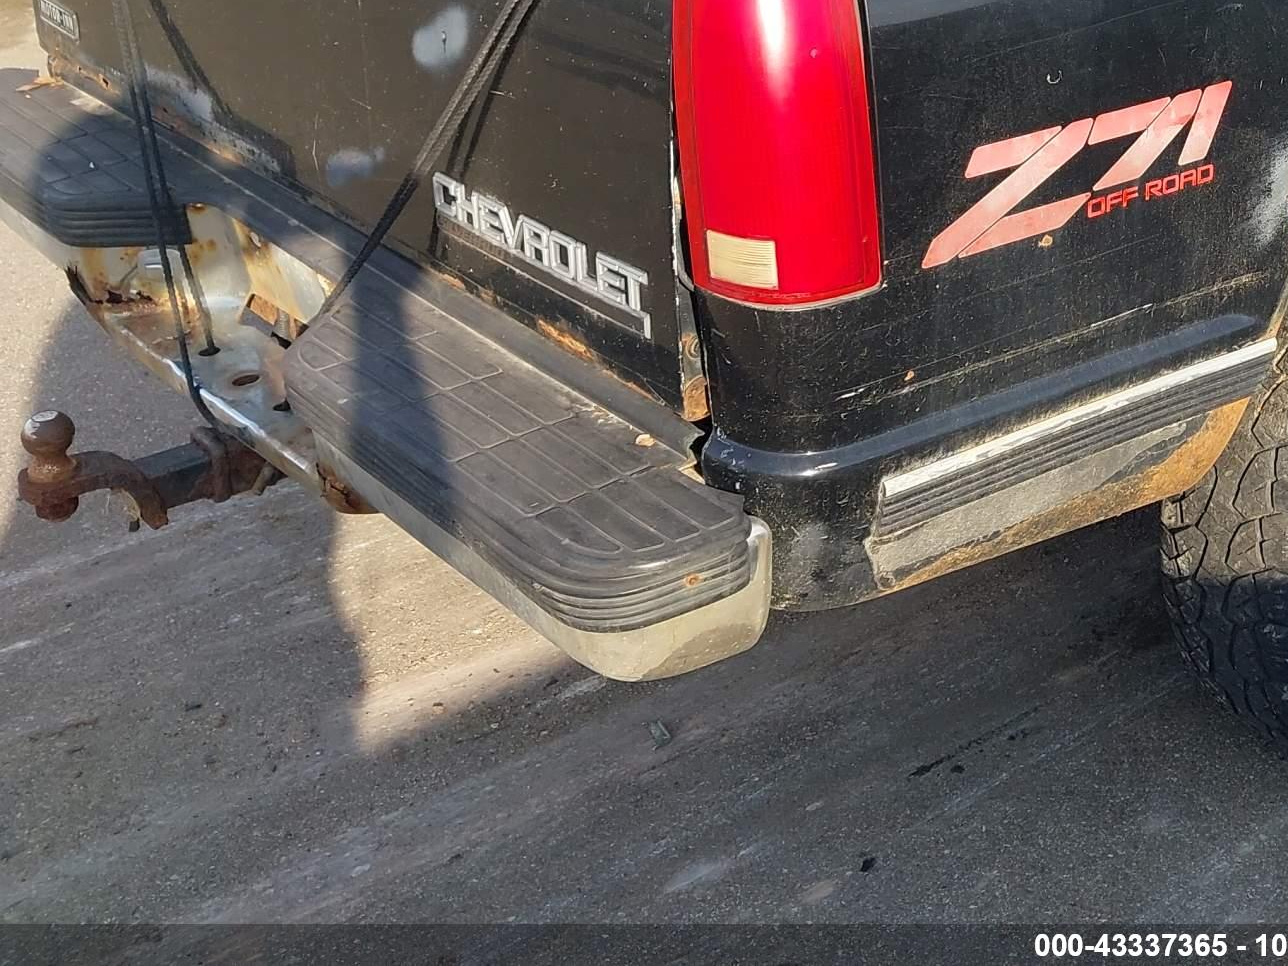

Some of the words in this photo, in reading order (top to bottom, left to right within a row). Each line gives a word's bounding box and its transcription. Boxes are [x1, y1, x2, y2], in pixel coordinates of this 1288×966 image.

[432, 171, 649, 313] CHEVROLET
[921, 80, 1232, 269] Z71
[1086, 185, 1139, 218] OFF
[1144, 163, 1214, 201] ROAD
